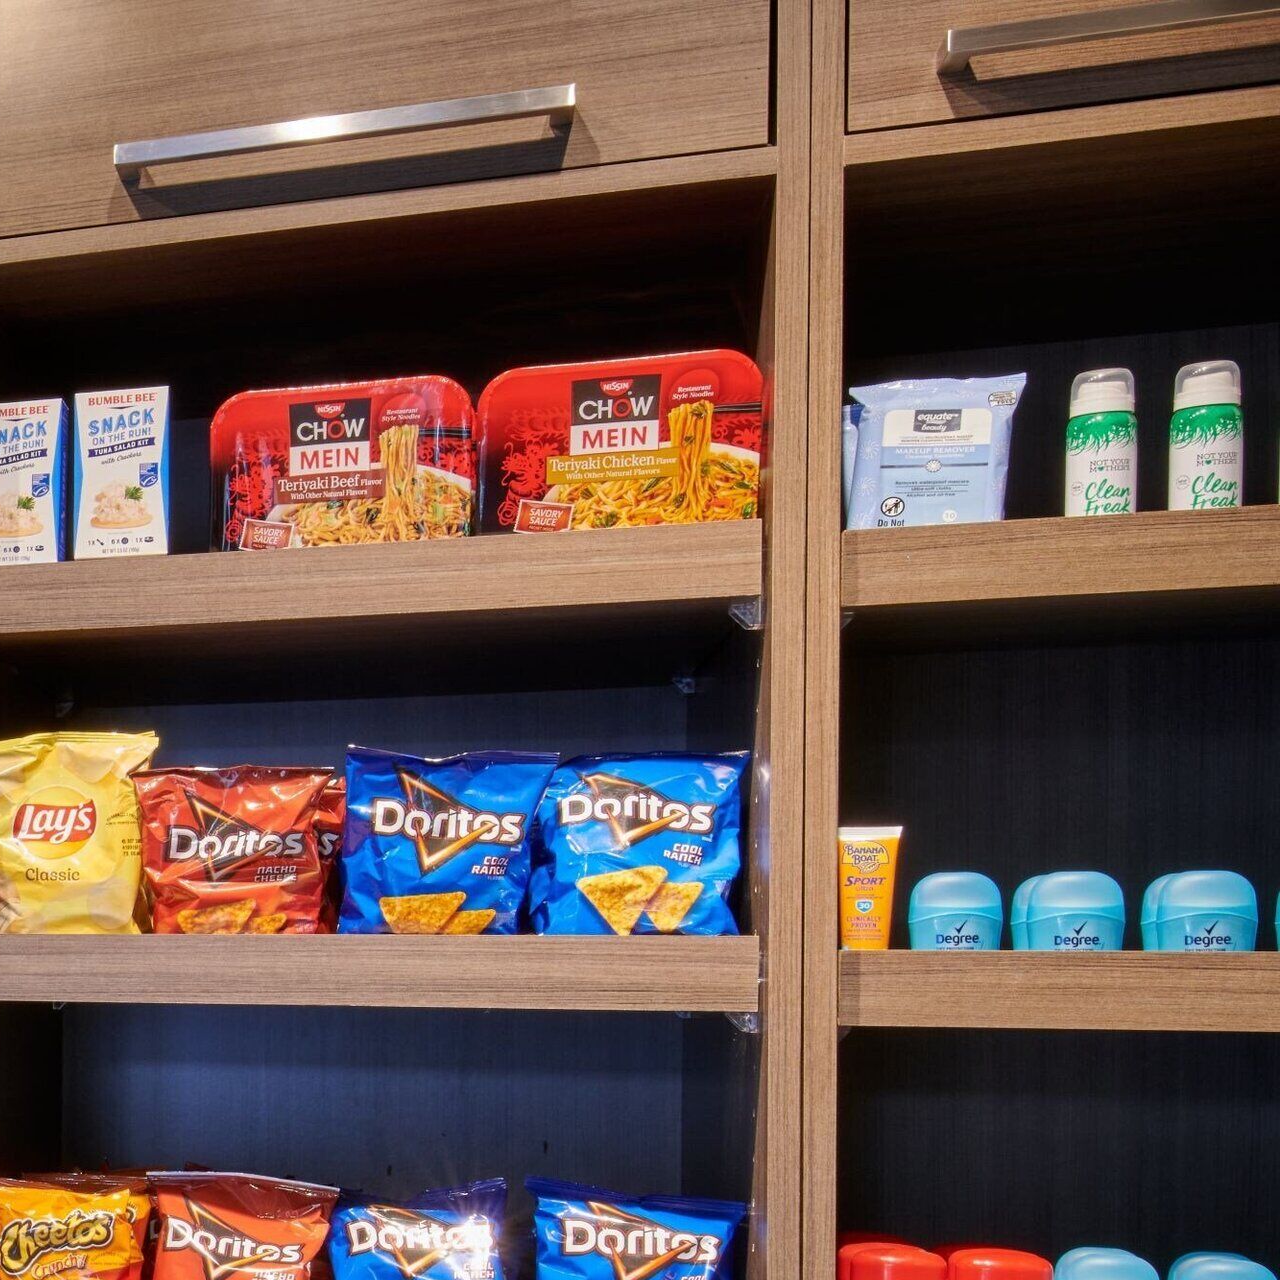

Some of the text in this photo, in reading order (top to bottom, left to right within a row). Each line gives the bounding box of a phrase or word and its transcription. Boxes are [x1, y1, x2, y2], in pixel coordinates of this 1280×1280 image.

[88, 393, 156, 406] BUMBLE BEE
[29, 405, 48, 414] BEE
[578, 395, 653, 420] CHOW
[88, 408, 155, 437] SNACK
[582, 426, 648, 449] MEIN
[2, 444, 20, 454] THE
[22, 439, 44, 451] RUN!
[895, 446, 976, 455] MAKEUP REMOVER
[300, 447, 360, 470] MEIN
[550, 453, 677, 473] Teriyaki Chicken Flavor
[1191, 473, 1237, 495] Clean
[1085, 482, 1130, 502] Clean
[530, 508, 564, 518] SAVORY
[529, 516, 557, 526] SAUCE
[877, 519, 905, 528] Do Not
[375, 795, 523, 845] Doritos
[560, 793, 712, 833] Doritos
[17, 800, 96, 843] Lay's
[168, 827, 303, 861] Doritos
[845, 845, 885, 856] BANANA
[484, 856, 510, 866] COOL
[664, 851, 702, 865] RANCH
[851, 854, 879, 865] BOAT
[24, 867, 80, 884] Classic
[257, 865, 297, 876] NACHO
[472, 864, 507, 876] RANCH
[844, 876, 886, 887] SPORT
[858, 901, 870, 910] 30
[935, 933, 980, 945] Degree
[1054, 934, 1100, 947] Degree
[1184, 934, 1232, 947] Degree
[2, 1209, 114, 1270] Cheetos
[167, 1221, 301, 1264] Doritos
[565, 1218, 719, 1262] Doritos
[31, 1254, 87, 1280] Crunchy
